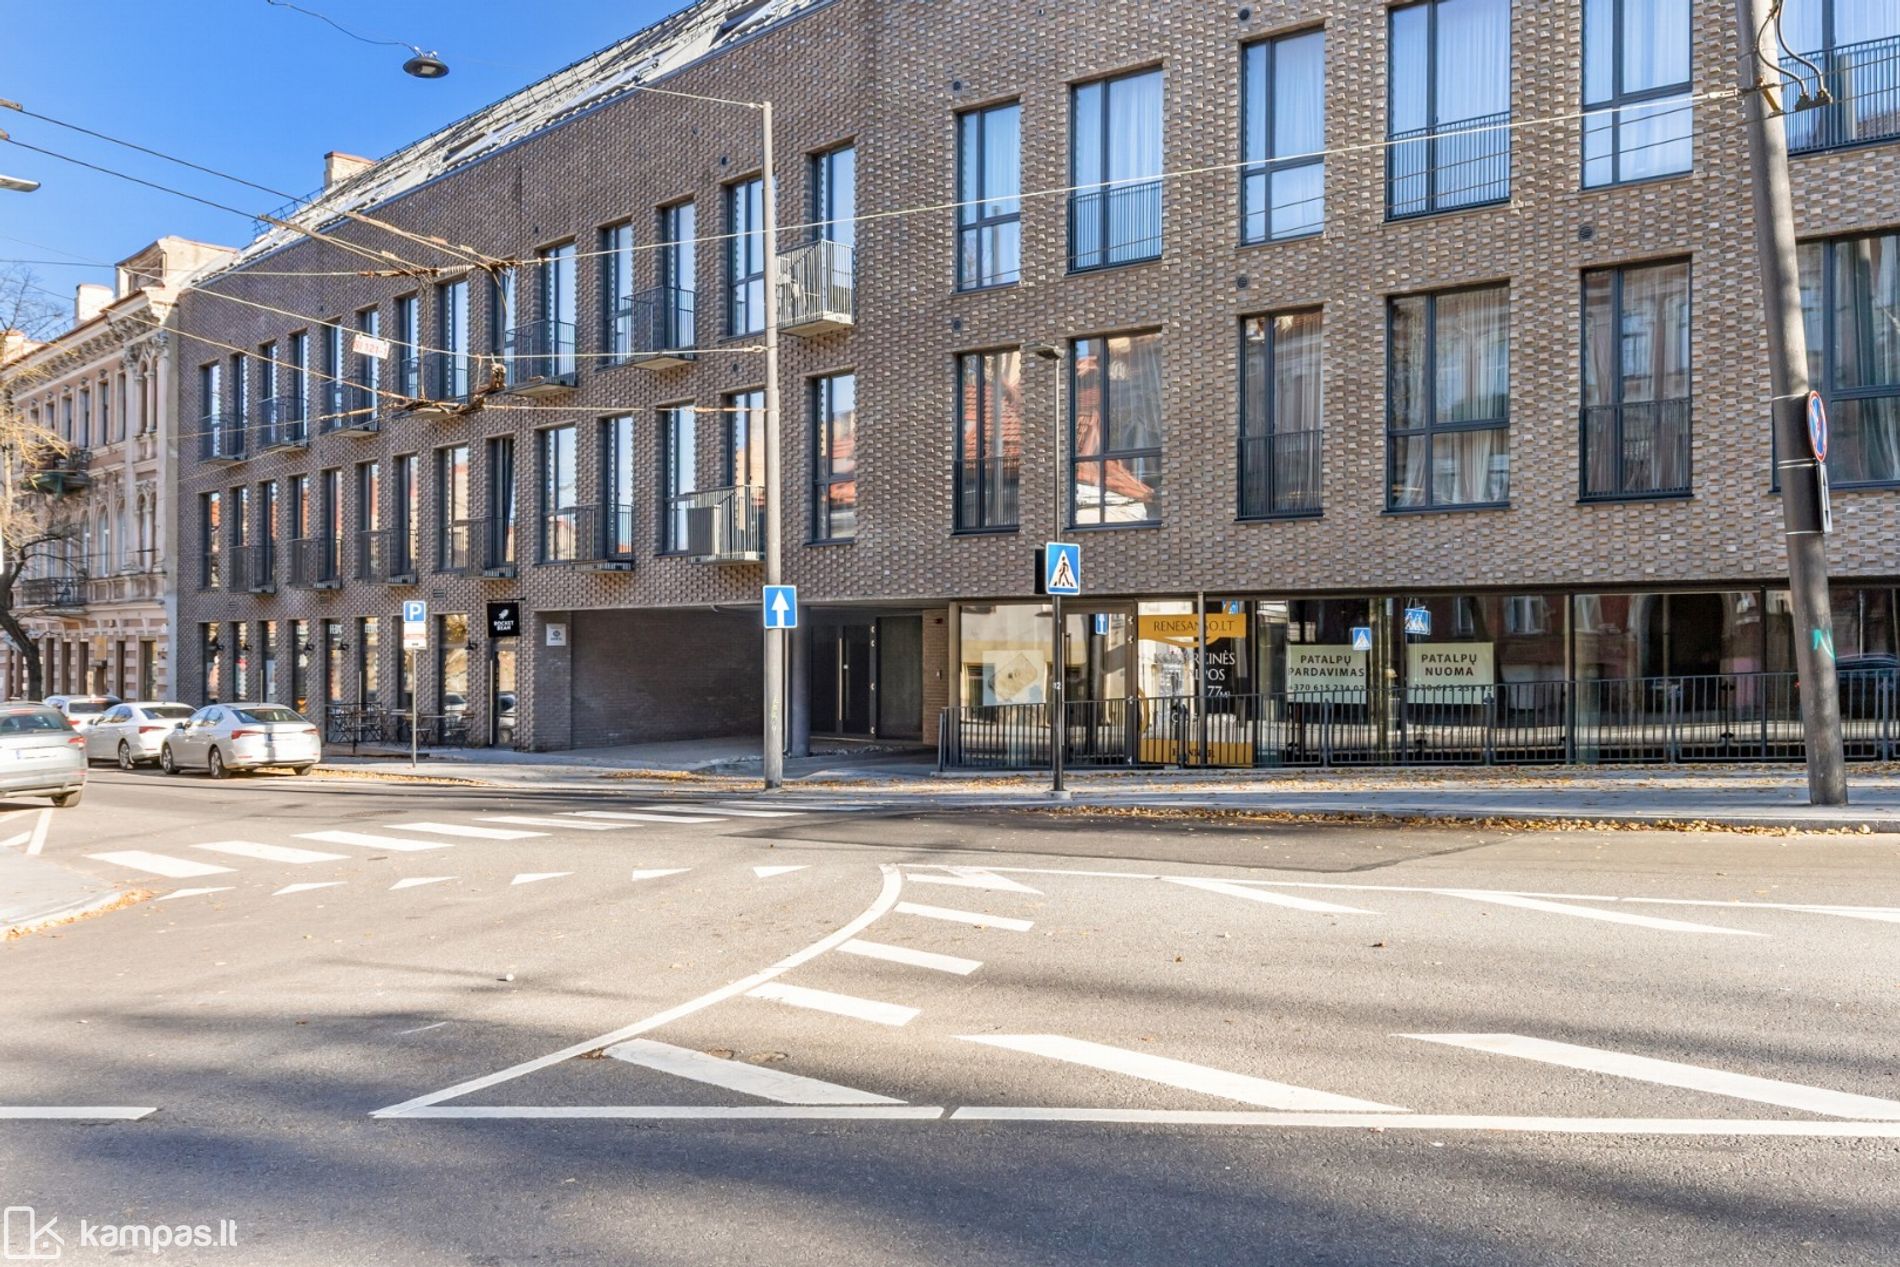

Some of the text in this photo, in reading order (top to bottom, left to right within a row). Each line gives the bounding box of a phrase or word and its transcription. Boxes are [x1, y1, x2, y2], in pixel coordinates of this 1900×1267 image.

[409, 603, 422, 621] P
[1300, 655, 1351, 666] PATALPŲ
[1421, 653, 1477, 665] PATALPŲ
[1288, 667, 1365, 677] PARDAVIMAS
[1425, 667, 1474, 676] NUOMA
